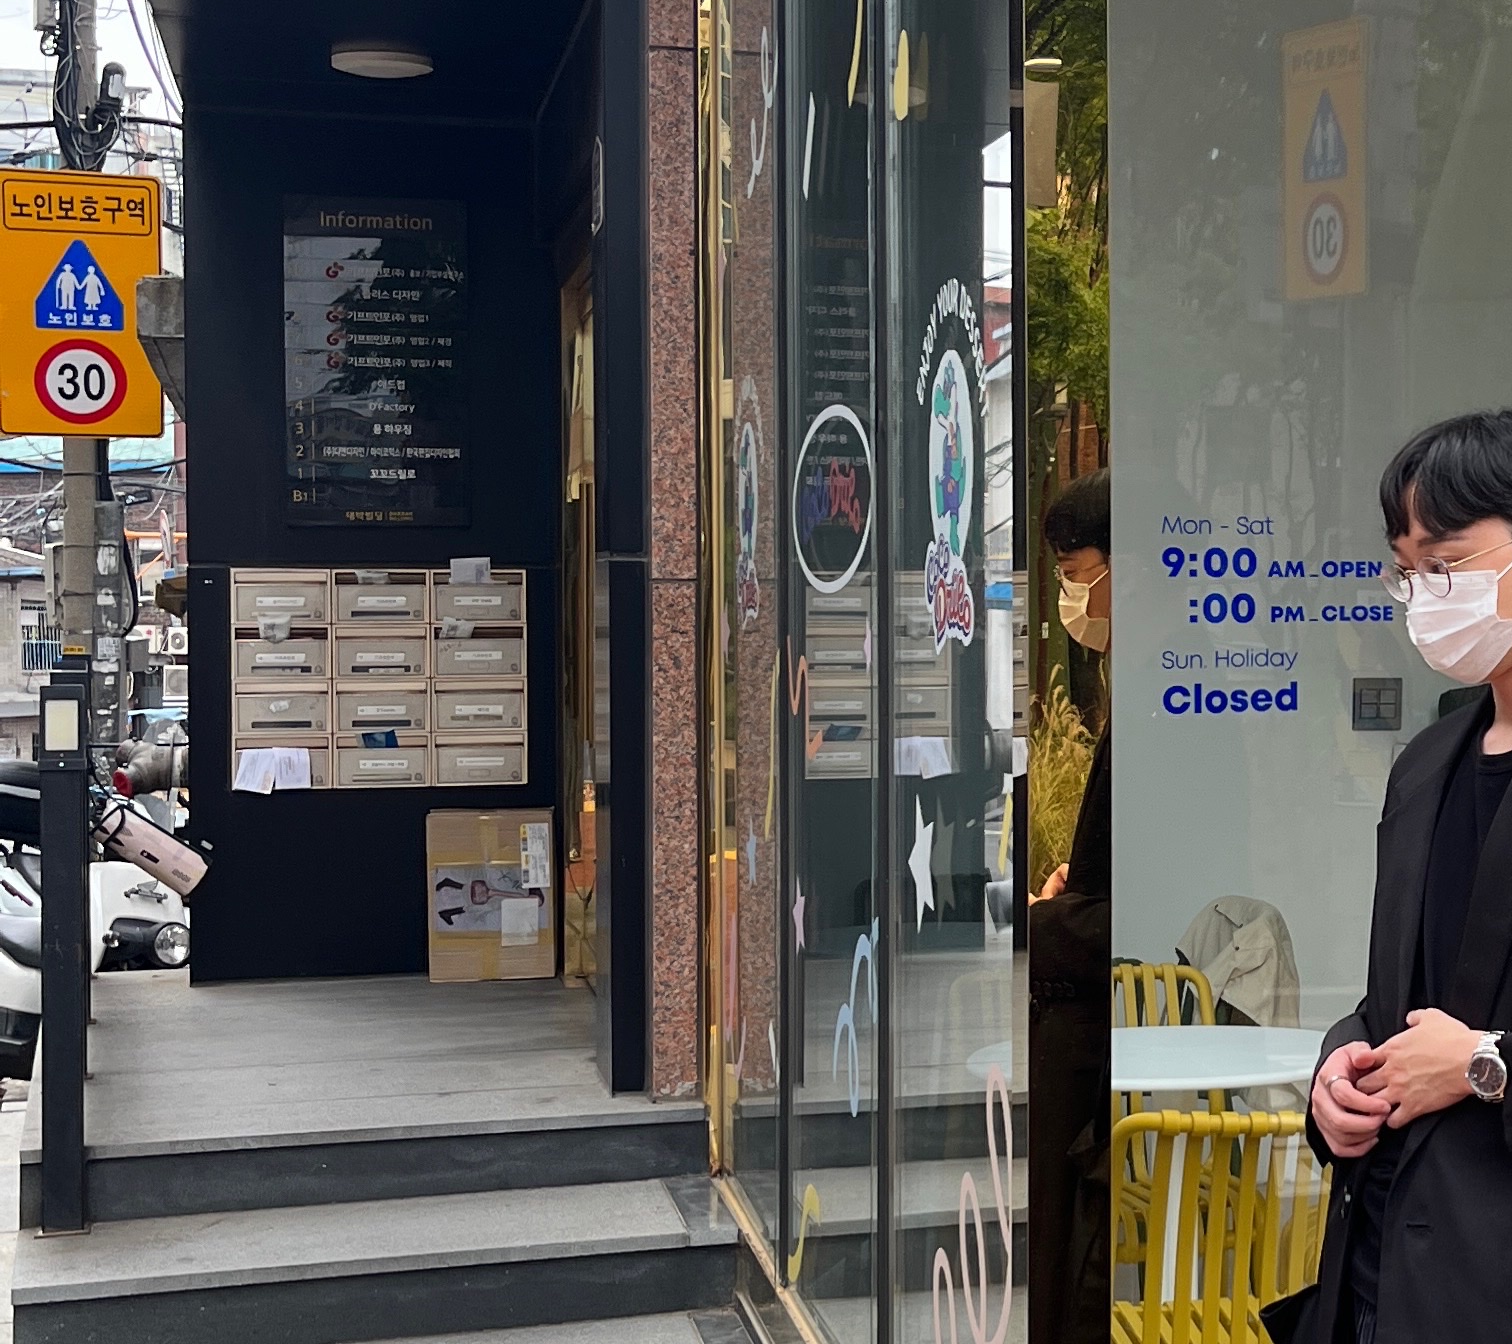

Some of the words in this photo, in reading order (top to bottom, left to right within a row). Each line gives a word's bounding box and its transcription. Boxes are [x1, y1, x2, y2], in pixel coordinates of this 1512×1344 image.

[10, 192, 146, 227] 노인보호구역
[319, 210, 434, 231] Information
[392, 290, 421, 302] 디자인
[57, 362, 106, 401] 30
[294, 400, 304, 412] 4
[368, 402, 416, 415] D'Factory
[295, 422, 305, 435] 3
[295, 445, 305, 457] 2
[292, 490, 309, 502] B1
[1161, 515, 1212, 535] Mon
[1236, 515, 1274, 536] Sat
[1161, 546, 1258, 578] 9:00
[1161, 650, 1208, 670] Sun.
[1215, 648, 1299, 672] Holiday
[1162, 681, 1299, 715] Closed
